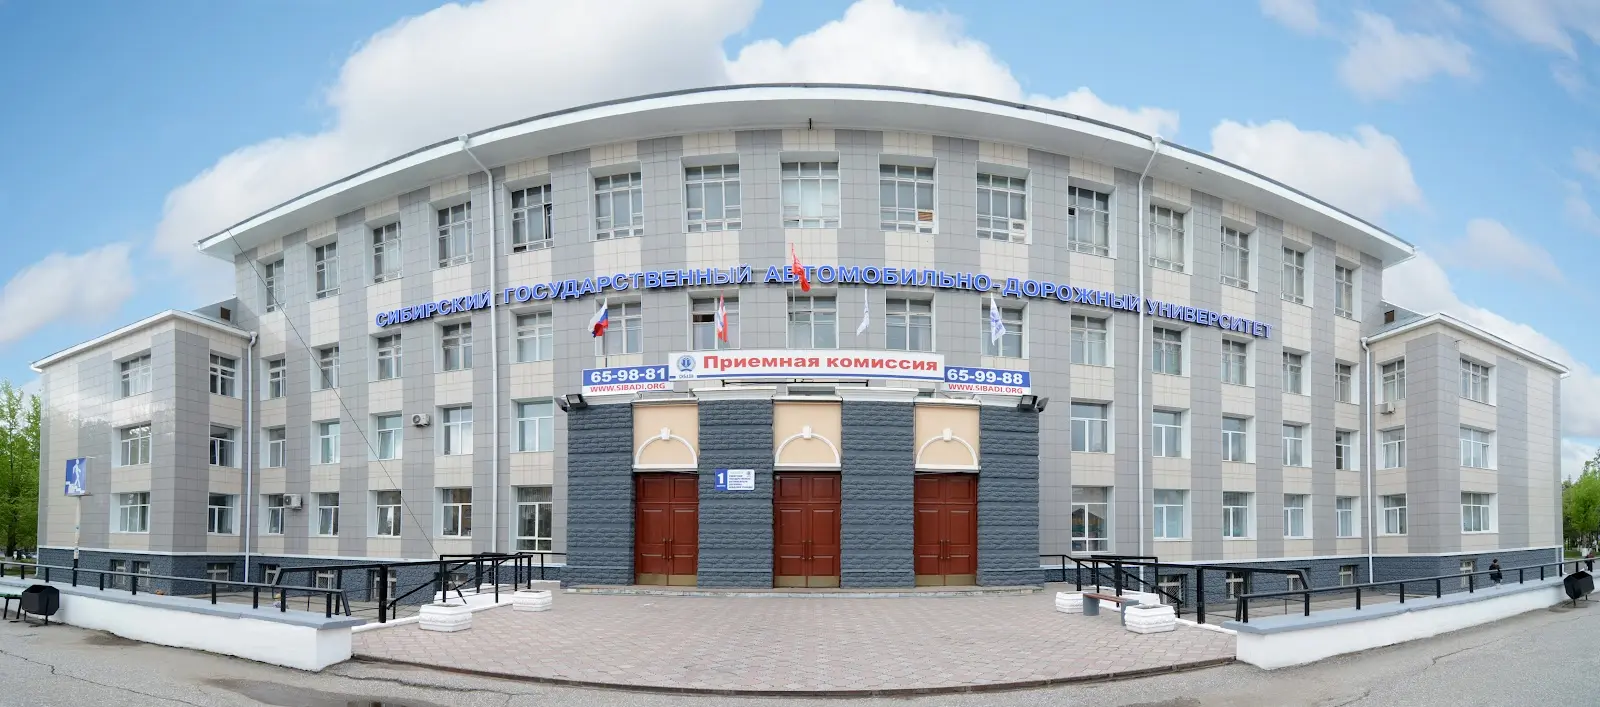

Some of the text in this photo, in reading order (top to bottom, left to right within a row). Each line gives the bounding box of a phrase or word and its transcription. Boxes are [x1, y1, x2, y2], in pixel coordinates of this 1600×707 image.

[375, 289, 493, 327] СИБИРСКИЙ
[504, 264, 753, 304] ГОСУДАРСТВЕННЫЙ
[1146, 297, 1273, 337] УНИВЕРСИТЕТ
[703, 354, 938, 371] Приемная комиссия
[590, 368, 666, 383] 65-98-81
[947, 369, 1023, 384] 65-99-88
[590, 382, 666, 393] WWW.SIBADI.ORG
[948, 383, 1023, 394] WWW.SIBADI.ORG
[717, 473, 724, 484] 1
